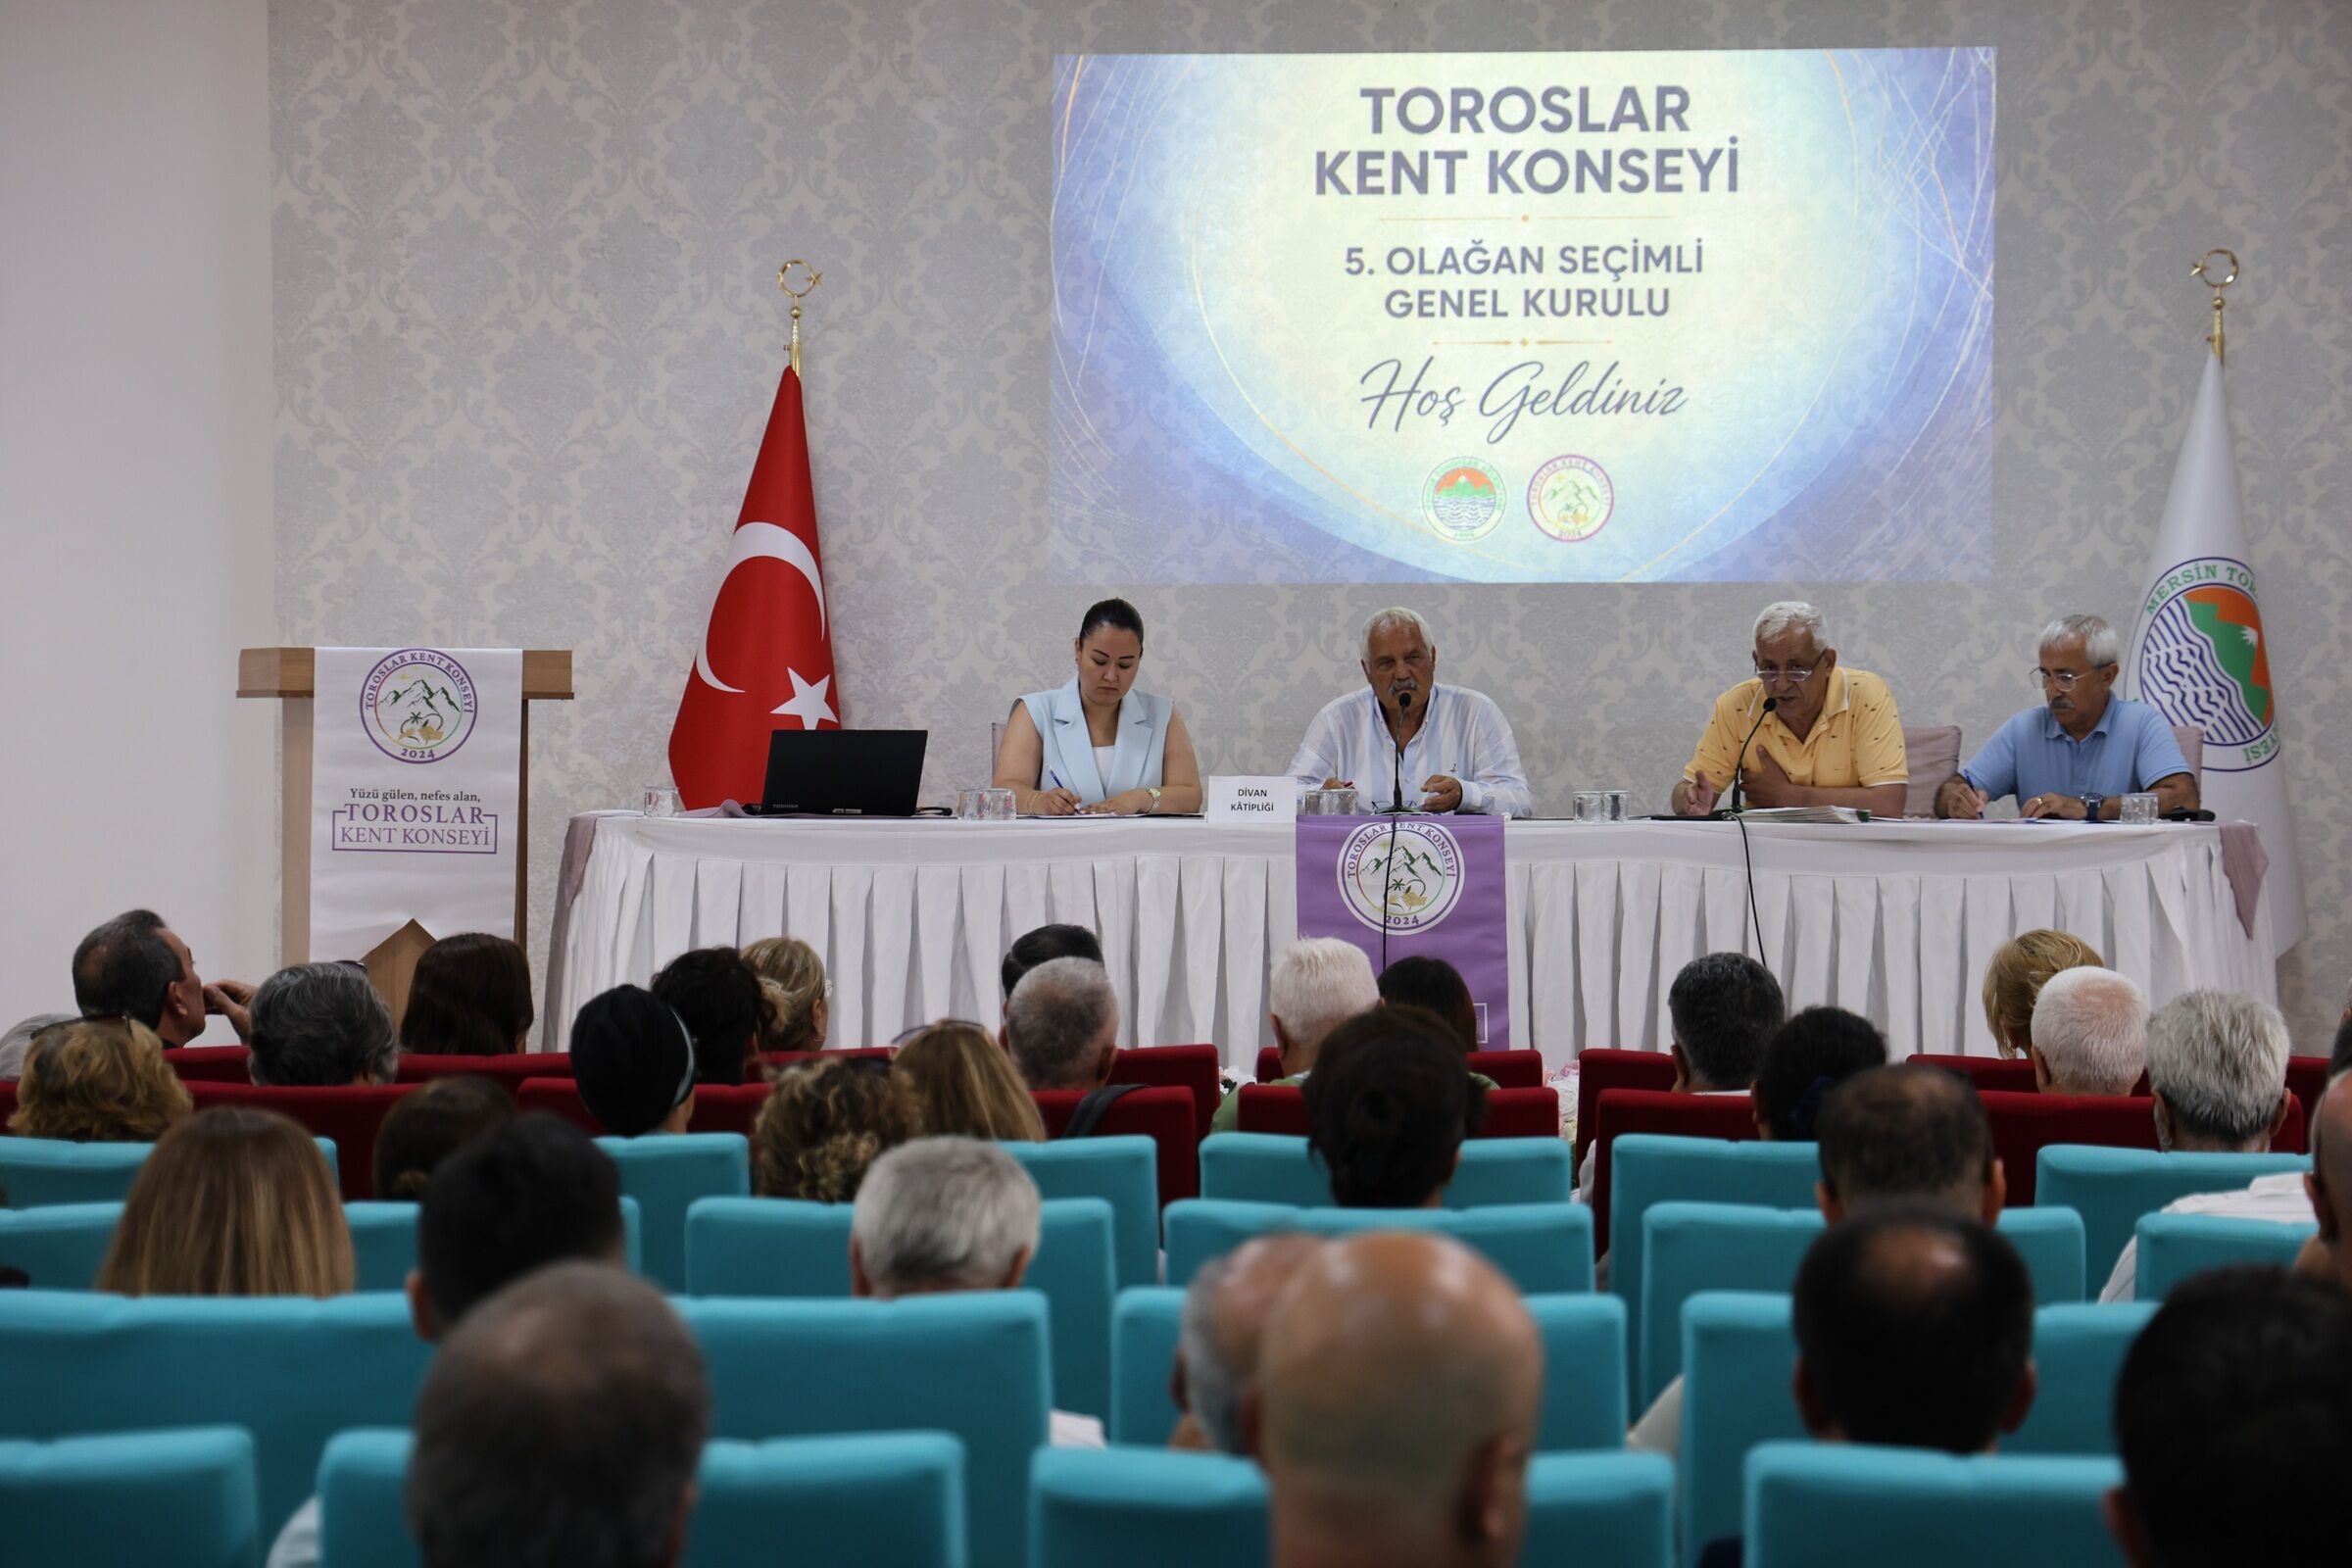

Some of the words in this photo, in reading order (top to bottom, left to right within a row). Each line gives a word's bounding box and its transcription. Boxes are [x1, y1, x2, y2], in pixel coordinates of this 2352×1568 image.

[1359, 85, 1691, 134] TOROSLAR
[1315, 149, 1468, 195] KENT
[1488, 135, 1740, 194] KONSEYİ
[1345, 246, 1375, 275] 5.
[1386, 239, 1544, 274] OLAĞAN
[1558, 238, 1704, 282] SEÇİMLİ
[1385, 288, 1509, 318] GENEL
[1523, 288, 1671, 317] KURULU
[1359, 356, 1466, 432] Hoş
[1478, 360, 1690, 445] Geldiniz
[2146, 563, 2218, 615] MERSİN
[365, 655, 408, 710] TOROSLAR
[410, 652, 445, 665] KENT
[401, 748, 436, 760] 2024
[350, 788, 379, 800] Yüzü
[381, 790, 418, 803] gülen,
[420, 791, 451, 802] nefes
[453, 791, 481, 804] alan,
[1231, 802, 1274, 811] KÂTİPLİĞİ
[1238, 787, 1267, 797] DİVAN
[344, 803, 485, 825] TOROSLAR
[340, 826, 398, 844] KENT
[402, 826, 490, 846] KONSEYİ
[1348, 824, 1388, 878] TOROSLAR
[1386, 914, 1420, 925] 2024
